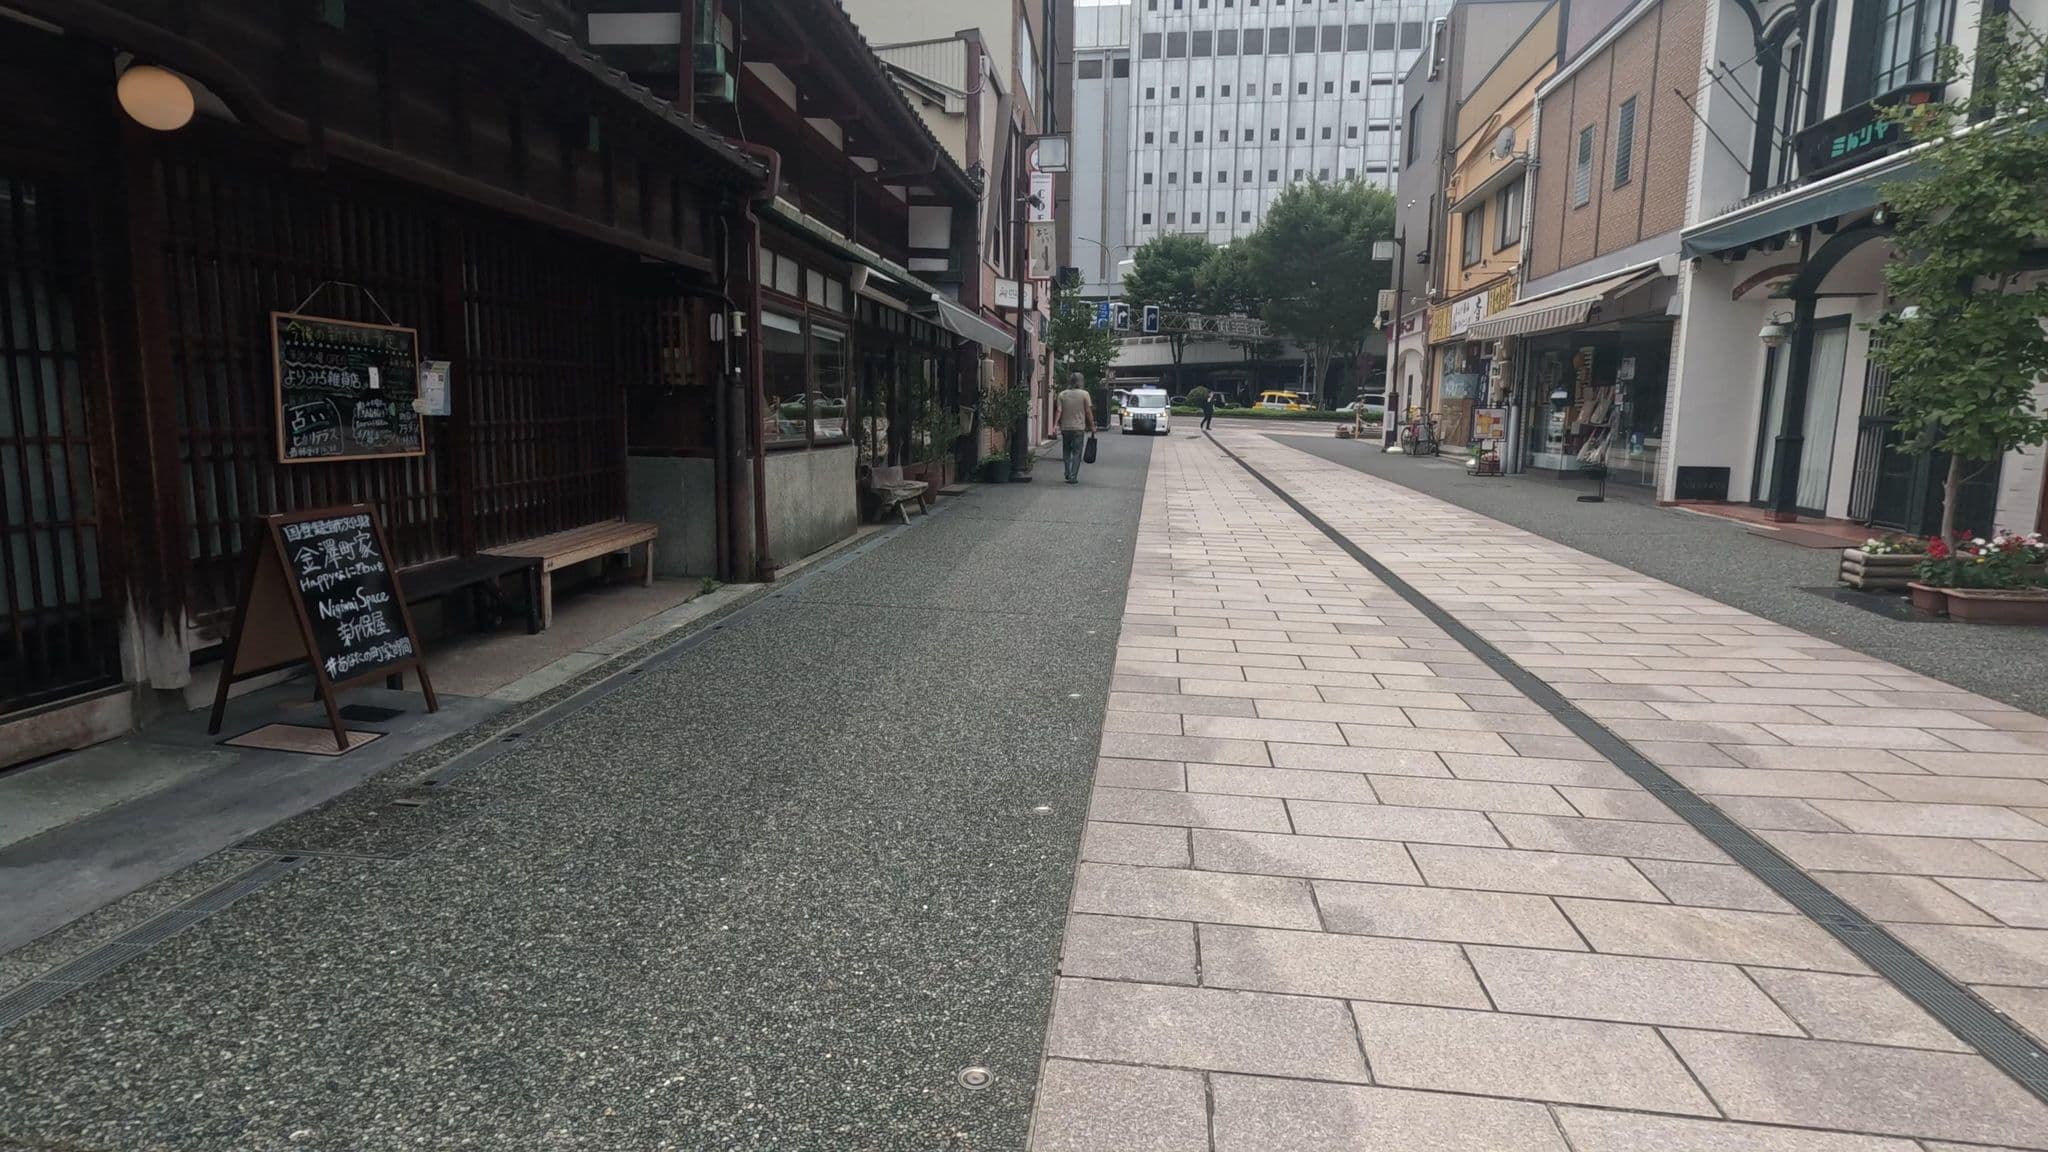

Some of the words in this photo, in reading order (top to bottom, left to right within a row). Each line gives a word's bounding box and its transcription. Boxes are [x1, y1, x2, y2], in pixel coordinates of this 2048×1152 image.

[291, 409, 327, 429] 占い
[293, 530, 380, 575] 金澤町家
[318, 598, 359, 620] Nigiwai
[356, 586, 390, 611] Space
[336, 611, 392, 647] 新保屋
